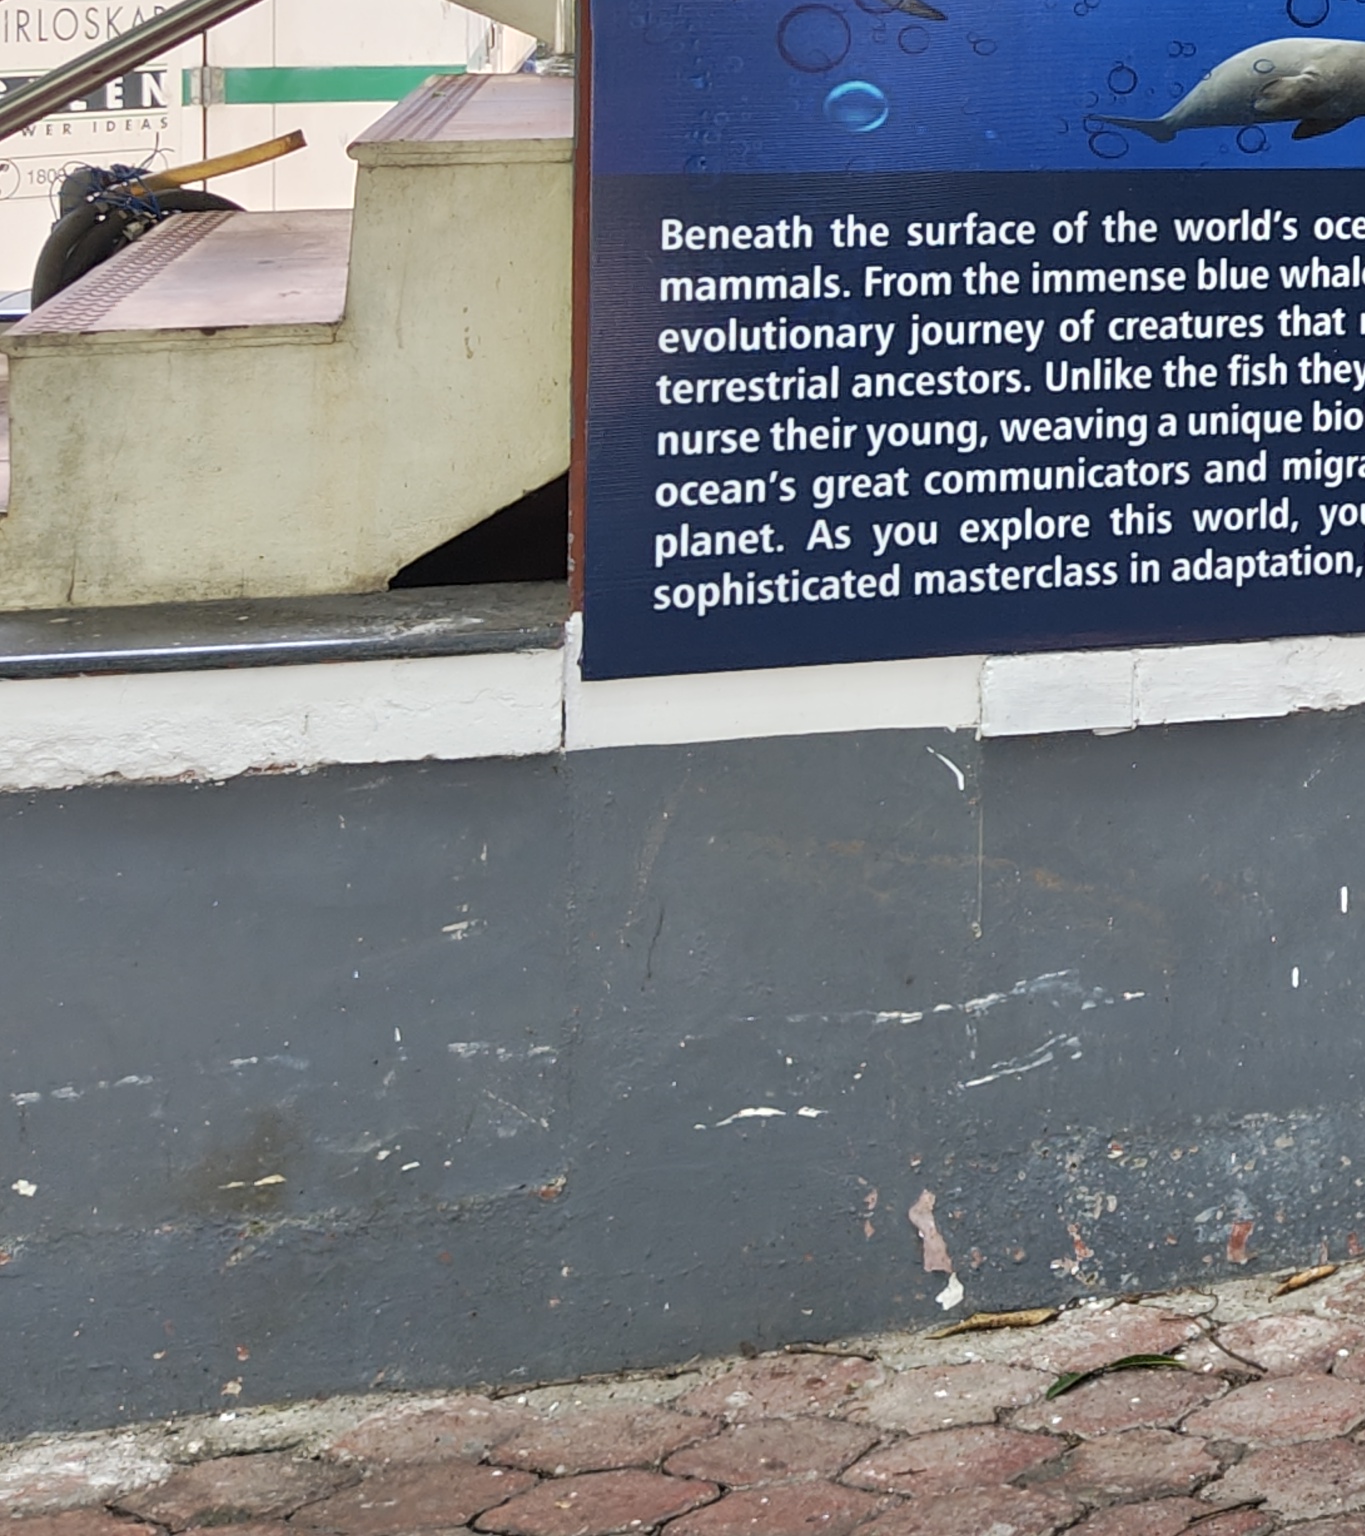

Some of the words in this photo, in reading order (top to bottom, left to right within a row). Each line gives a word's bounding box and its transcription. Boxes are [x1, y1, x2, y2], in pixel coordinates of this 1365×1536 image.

[92, 117, 168, 133] IDEAS
[661, 214, 813, 251] Beneath
[829, 213, 890, 248] the
[907, 212, 1036, 247] surface
[1052, 210, 1089, 244] of
[1101, 210, 1158, 243] the
[660, 265, 851, 302] mammals.
[864, 266, 952, 297] From
[962, 261, 1020, 295] the
[1032, 261, 1186, 294] immense
[1197, 257, 1270, 291] blue
[658, 316, 895, 357] evolutionary
[907, 313, 1045, 356] journey
[1059, 308, 1095, 343] of
[1108, 311, 1264, 341] creatures
[1277, 304, 1346, 337] that
[656, 365, 839, 405] terrestrial
[851, 365, 1031, 398] ancestors.
[1045, 356, 1153, 392] Unlike
[1162, 355, 1218, 388] the
[1227, 353, 1288, 387] fish
[657, 428, 761, 456] nurse
[769, 416, 858, 452] their
[866, 420, 988, 457] young,
[999, 407, 1148, 447] weaving
[1157, 413, 1177, 437] a
[1188, 403, 1303, 443] unique
[812, 467, 910, 509] great
[924, 456, 1190, 495] communicators
[1204, 449, 1267, 484] and
[655, 523, 784, 568] planet.
[806, 519, 851, 551] As
[872, 521, 938, 557] you
[959, 507, 1090, 550] explore
[1109, 502, 1173, 536] this
[1192, 496, 1299, 533] world,
[653, 563, 900, 617] sophisticated
[914, 554, 1118, 596] masterclass
[1130, 551, 1160, 584] in
